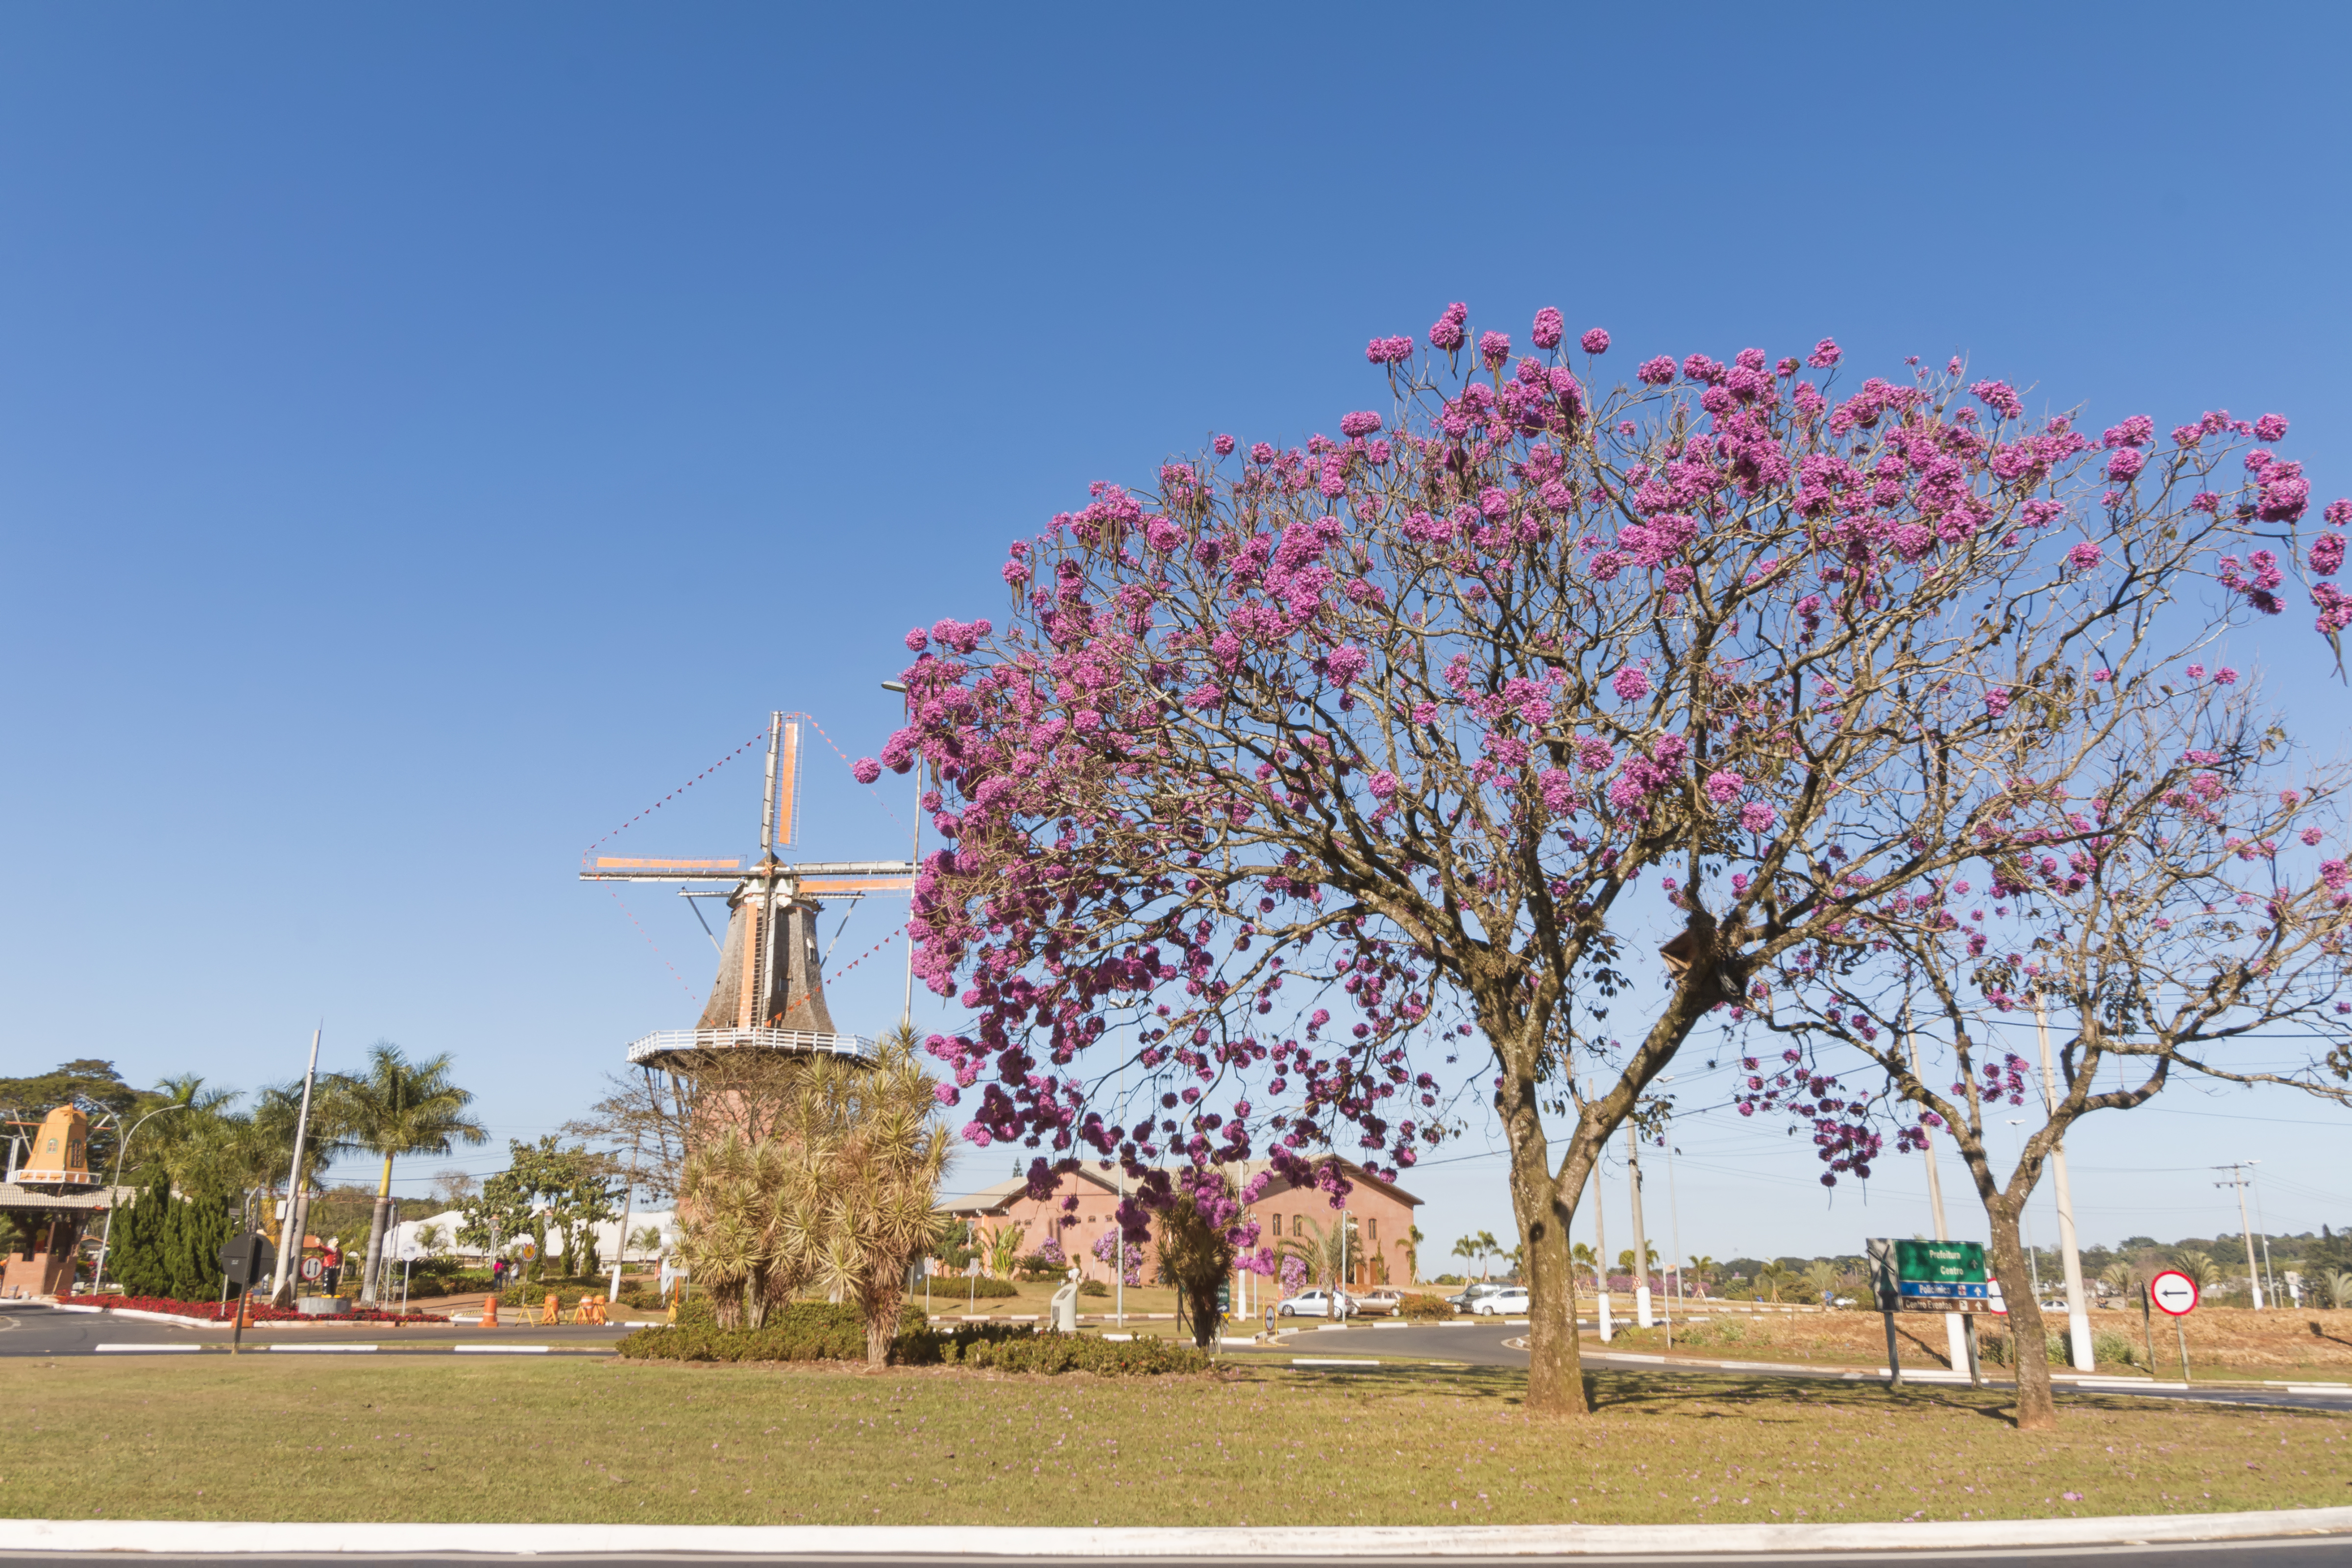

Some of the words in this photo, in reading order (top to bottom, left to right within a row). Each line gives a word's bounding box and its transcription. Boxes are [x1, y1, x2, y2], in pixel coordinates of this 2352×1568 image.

[1929, 1250, 1961, 1259] Prefeitura
[1940, 1266, 1963, 1275] Centro
[1906, 1300, 1927, 1309] Centro
[1927, 1300, 1952, 1310] Eventos
